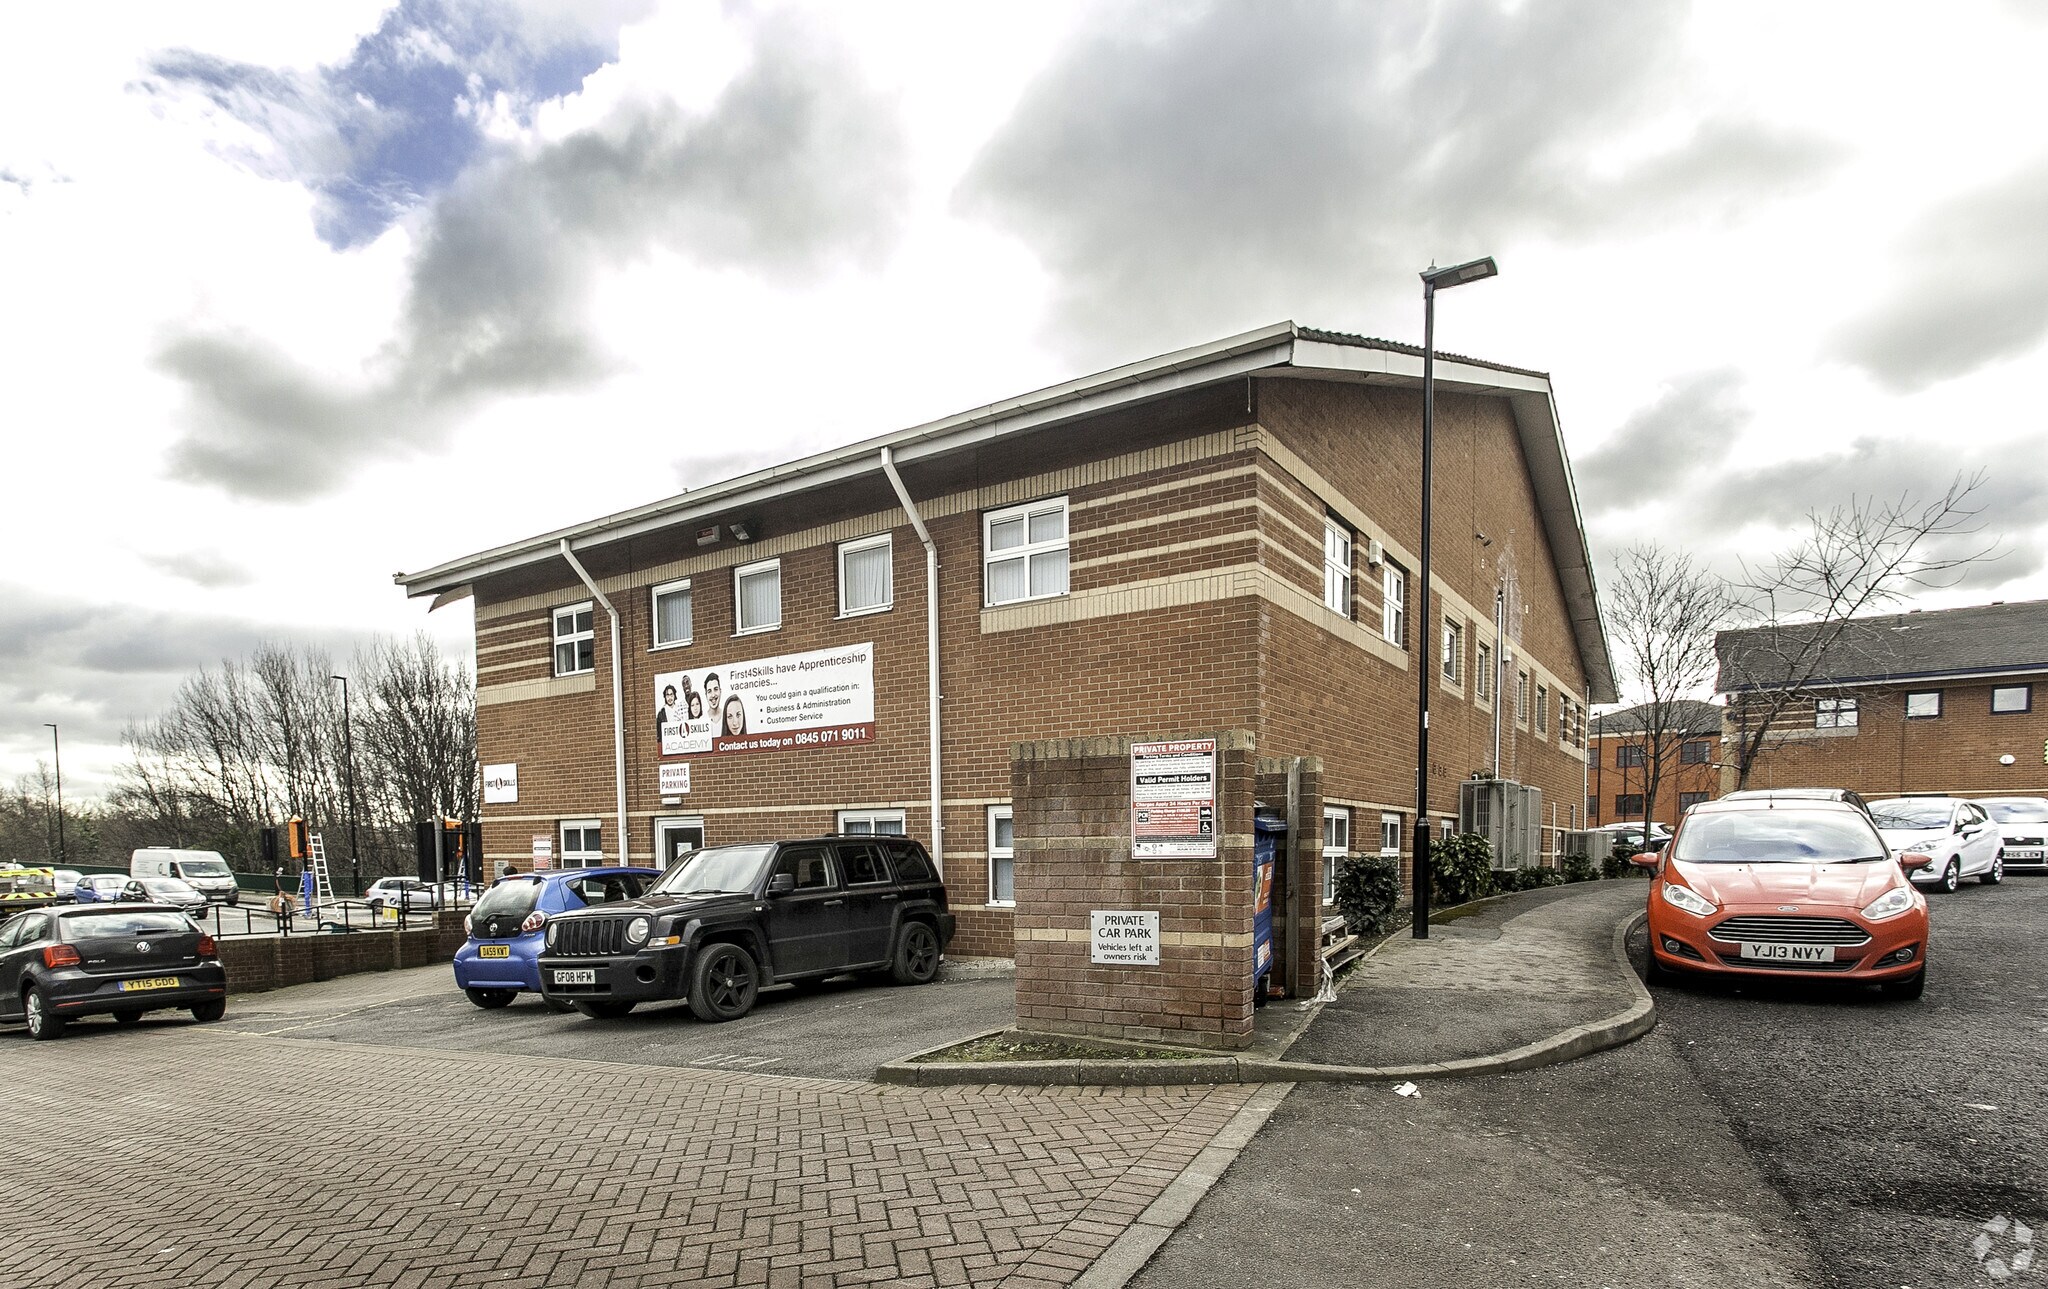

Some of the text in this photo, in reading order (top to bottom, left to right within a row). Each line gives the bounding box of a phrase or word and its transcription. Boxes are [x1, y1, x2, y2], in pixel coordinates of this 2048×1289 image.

[730, 652, 867, 680] First4Skills have Apprenticeship
[730, 678, 777, 690] vacancies...
[756, 694, 767, 702] You
[769, 691, 786, 700] could
[788, 688, 801, 699] gain
[809, 684, 850, 696] qualification
[851, 682, 860, 690] in:
[766, 703, 795, 713] Business
[802, 698, 851, 709] Administration
[766, 712, 823, 724] Customer Service
[664, 726, 678, 737] FIRST
[690, 723, 709, 734] SKILLS
[665, 739, 709, 751] ACADEMY
[719, 727, 866, 751] Contact us today on 0845 071 9011
[1133, 742, 1212, 754] PRIVATE PROPERTY
[662, 768, 686, 777] PRIVATE
[662, 780, 688, 789] PARKING
[1139, 774, 1207, 784] Valid Permit Holders
[1104, 915, 1145, 926] PRIVATE
[1098, 928, 1152, 938] CAR PARK
[1098, 943, 1127, 951] Vehicles
[1129, 943, 1142, 952] left
[1752, 944, 1825, 960] YJ13 NVY
[1103, 953, 1147, 961] owners risk
[127, 979, 152, 989] YT15
